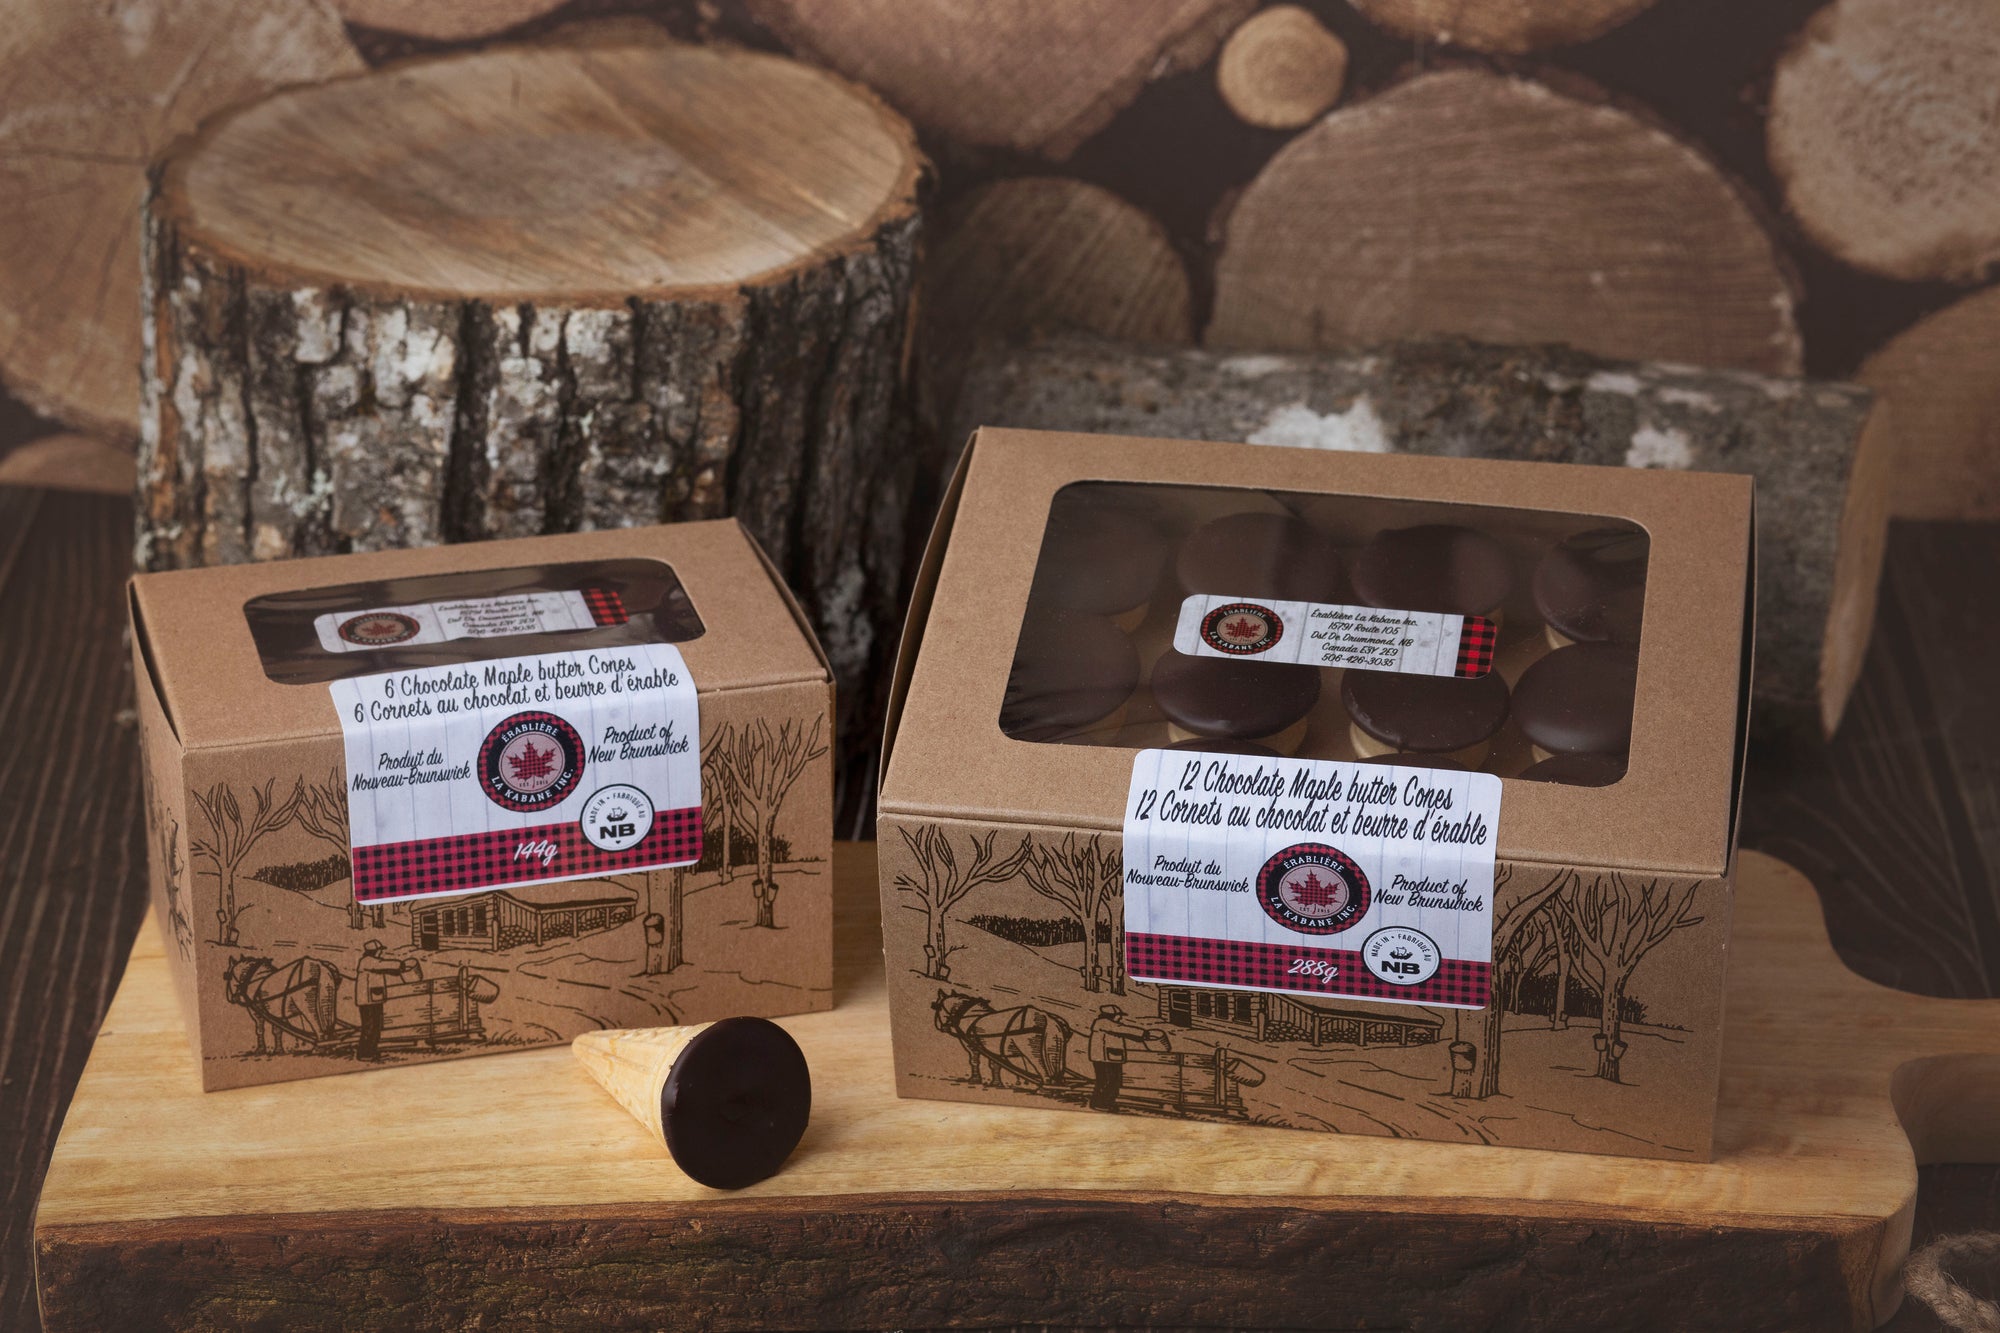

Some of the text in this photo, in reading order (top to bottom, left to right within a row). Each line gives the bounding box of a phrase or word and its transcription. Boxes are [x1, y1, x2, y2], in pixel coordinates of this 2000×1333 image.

[1328, 621, 1401, 635] 15791 Route 105
[1354, 613, 1366, 622] La
[1322, 642, 1358, 653] Canada
[1379, 648, 1399, 656] 2E9
[1328, 632, 1340, 641] De
[1321, 652, 1396, 667] 506-426-3035
[384, 654, 636, 698] 6 Chocolate Maple butter Cones
[354, 667, 678, 723] 6 Cornets au chocolat et beurre d'érable
[501, 722, 560, 743] ÉRABLIÈRE
[603, 720, 674, 745] Product of
[378, 747, 444, 770] Produit du
[588, 734, 690, 764] New Brunswick
[352, 760, 472, 792] Nouveau-Brunswick
[491, 768, 574, 803] LA KABANE INC.
[1178, 760, 1454, 810] 12 Chocolate Maple butter Cones
[590, 806, 600, 824] MADE
[597, 798, 606, 807] IN
[1134, 789, 1488, 846] 12 Cornets au chocolat et beurre d'érable
[600, 822, 636, 840] NB
[514, 840, 558, 866] 144g
[1154, 854, 1222, 876] Produit du
[1284, 856, 1345, 872] ÉRABLIÈRE
[1126, 868, 1250, 894] Nouveau-Brunswick
[1391, 874, 1468, 899] Product of
[1270, 896, 1358, 927] LA KABANE INC.
[1373, 888, 1484, 912] New Brunswick
[1371, 942, 1382, 957] MADE
[1380, 936, 1390, 944] IN
[1287, 958, 1339, 984] 288g
[1381, 960, 1420, 974] NB
